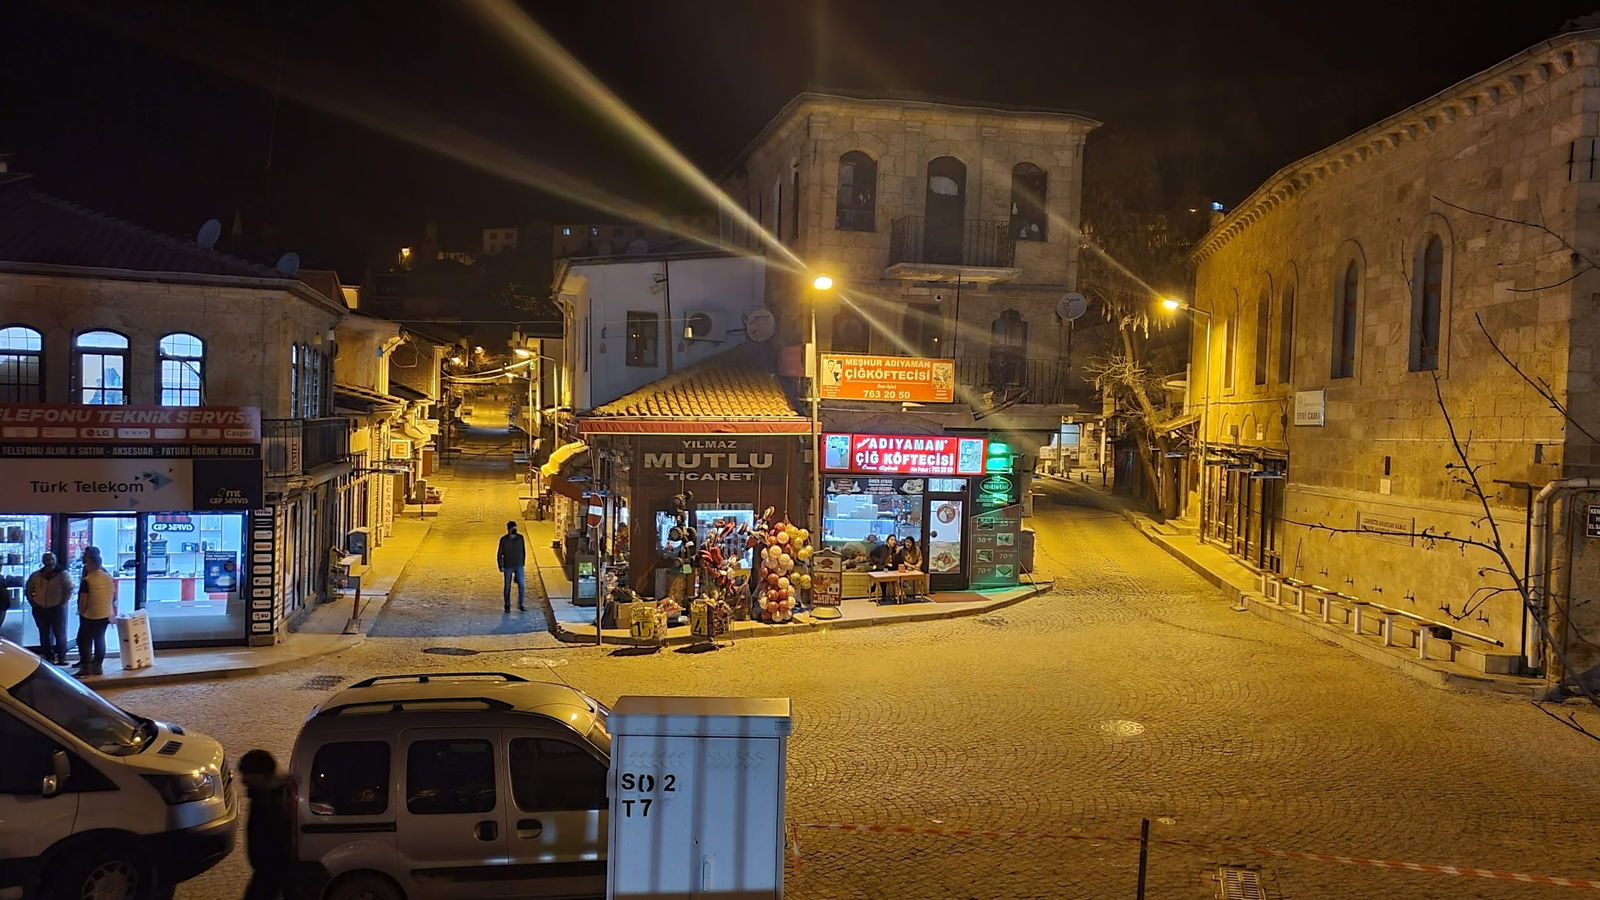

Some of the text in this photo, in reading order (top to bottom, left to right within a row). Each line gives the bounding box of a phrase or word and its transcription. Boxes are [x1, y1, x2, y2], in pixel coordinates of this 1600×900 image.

[885, 360, 930, 369] ADIYAMAN
[863, 390, 910, 399] 763 20 50
[226, 430, 252, 438] Casper
[395, 443, 405, 455] E
[682, 440, 737, 448] YILMAZ
[868, 438, 944, 451] ADIYAMAN
[113, 447, 153, 456] AKSESUAR
[162, 447, 190, 456] FATURA
[644, 453, 773, 468] MUTLU
[856, 451, 954, 467] ÇİĞ KÖFTECİSİ
[665, 471, 755, 480] TİCARET
[30, 481, 144, 493] Türk Telekom
[664, 774, 676, 792] 2
